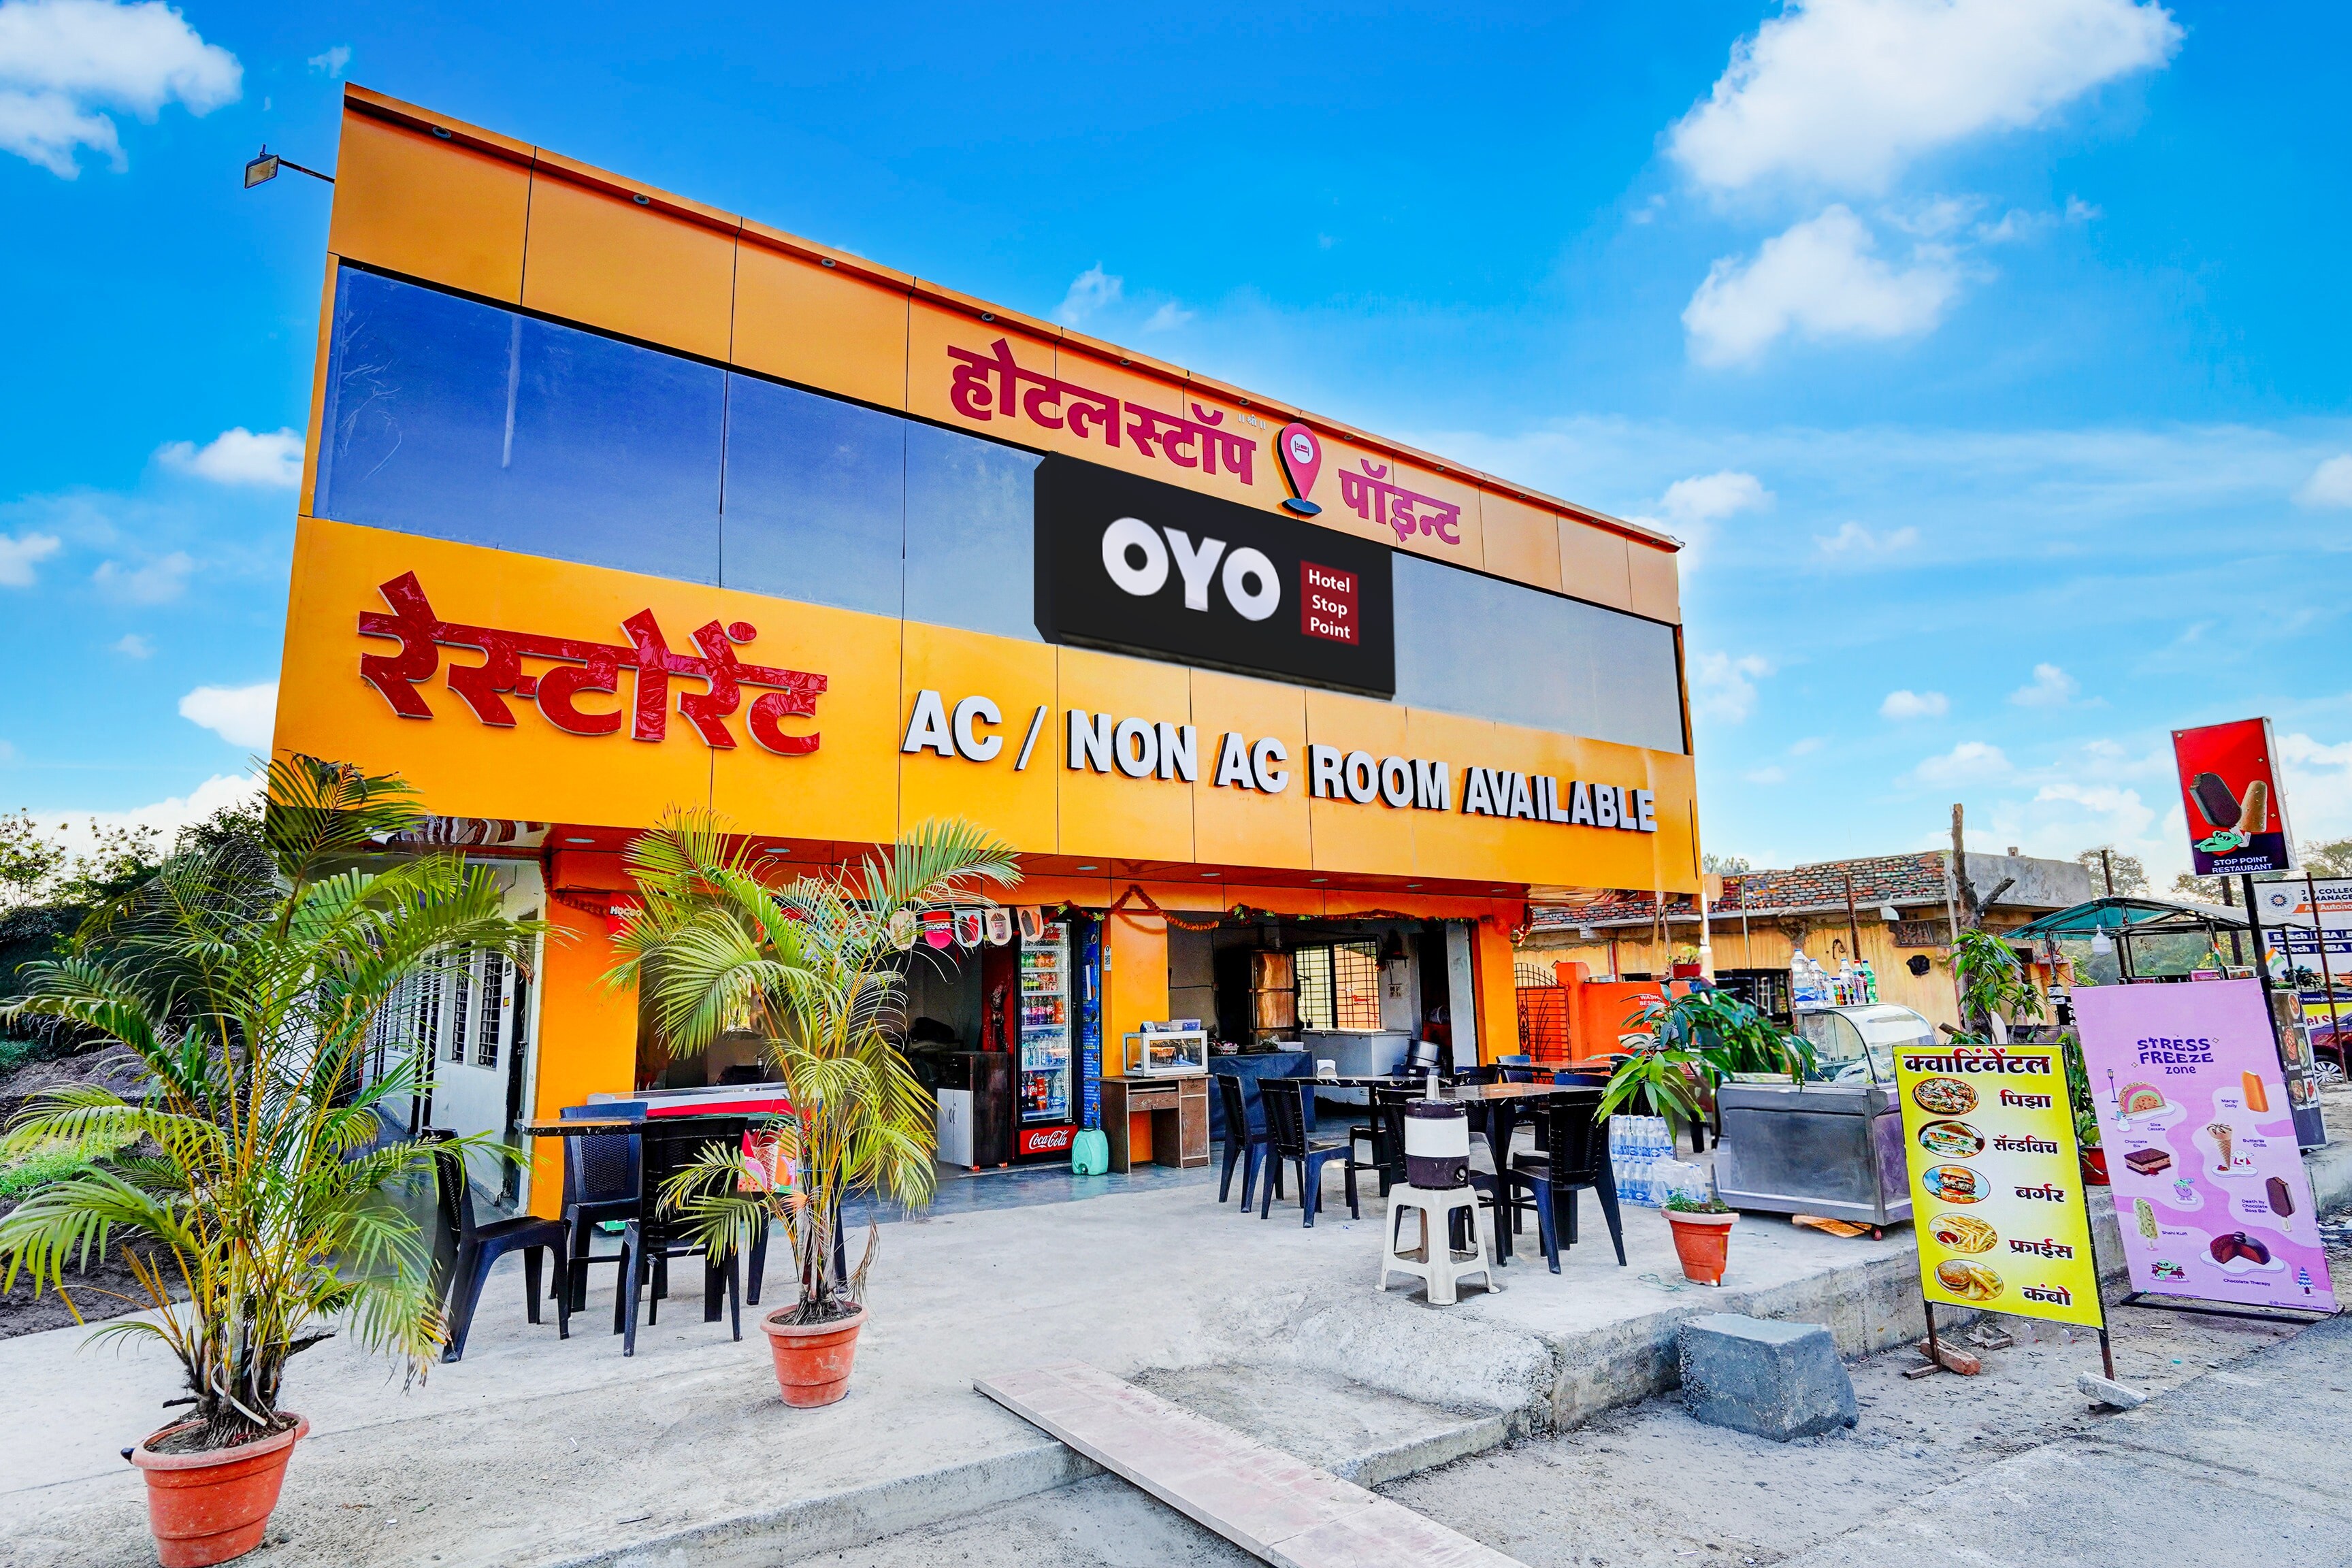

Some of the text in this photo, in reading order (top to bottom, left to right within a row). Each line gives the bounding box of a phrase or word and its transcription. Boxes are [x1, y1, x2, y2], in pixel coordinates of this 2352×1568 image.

[1338, 459, 1460, 545] पॉइन्ट
[1102, 517, 1281, 621] OYO
[1309, 569, 1350, 593] Hotel
[1312, 594, 1348, 619] Stop
[1310, 617, 1351, 639] Point
[358, 570, 828, 756] रेस्टोरेंट
[900, 689, 1002, 762] AC
[1066, 709, 1198, 782] NON
[1214, 732, 1289, 794] AC
[1308, 744, 1451, 811] ROOM
[1462, 766, 1658, 832] AVAILABLE
[2212, 863, 2272, 874] RESTAURANT
[2214, 856, 2268, 866] STOP POINT
[2137, 1036, 2210, 1052] STRESS
[2140, 1051, 2214, 1064] FREEZE
[2165, 1065, 2196, 1075] zone
[1999, 1089, 2051, 1109] पिझा
[1028, 1130, 1070, 1150] Coca-Cola
[2014, 1183, 2065, 1203] बर्गर
[2009, 1238, 2073, 1259] फ्राईस
[2022, 1284, 2071, 1306] कंबो
